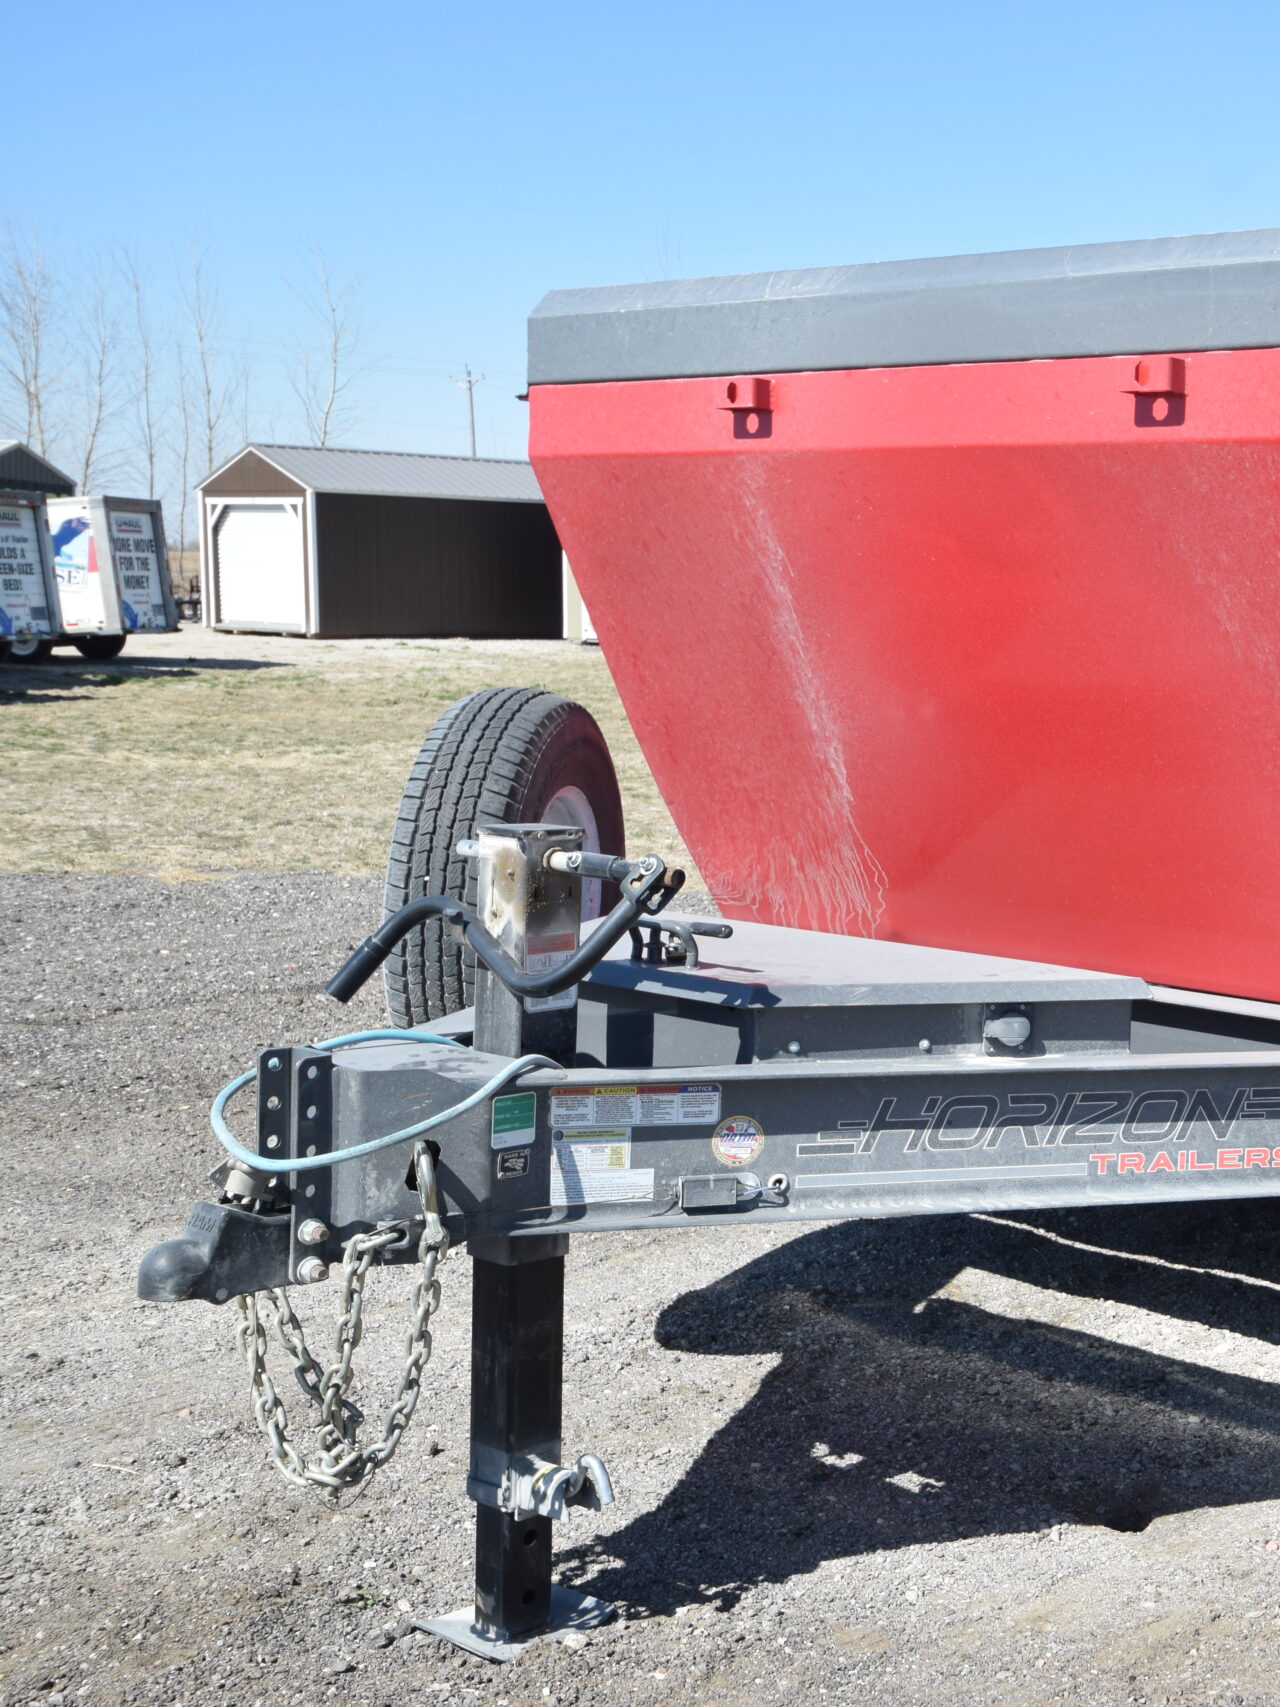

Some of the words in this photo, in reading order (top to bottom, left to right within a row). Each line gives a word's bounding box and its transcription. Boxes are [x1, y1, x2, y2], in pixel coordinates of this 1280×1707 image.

[20, 546, 26, 559] A
[119, 556, 135, 571] FOR
[136, 556, 151, 571] THE
[123, 574, 150, 590] MONEY
[687, 1085, 713, 1093] NOTICE
[857, 1087, 1249, 1154] HORIZON
